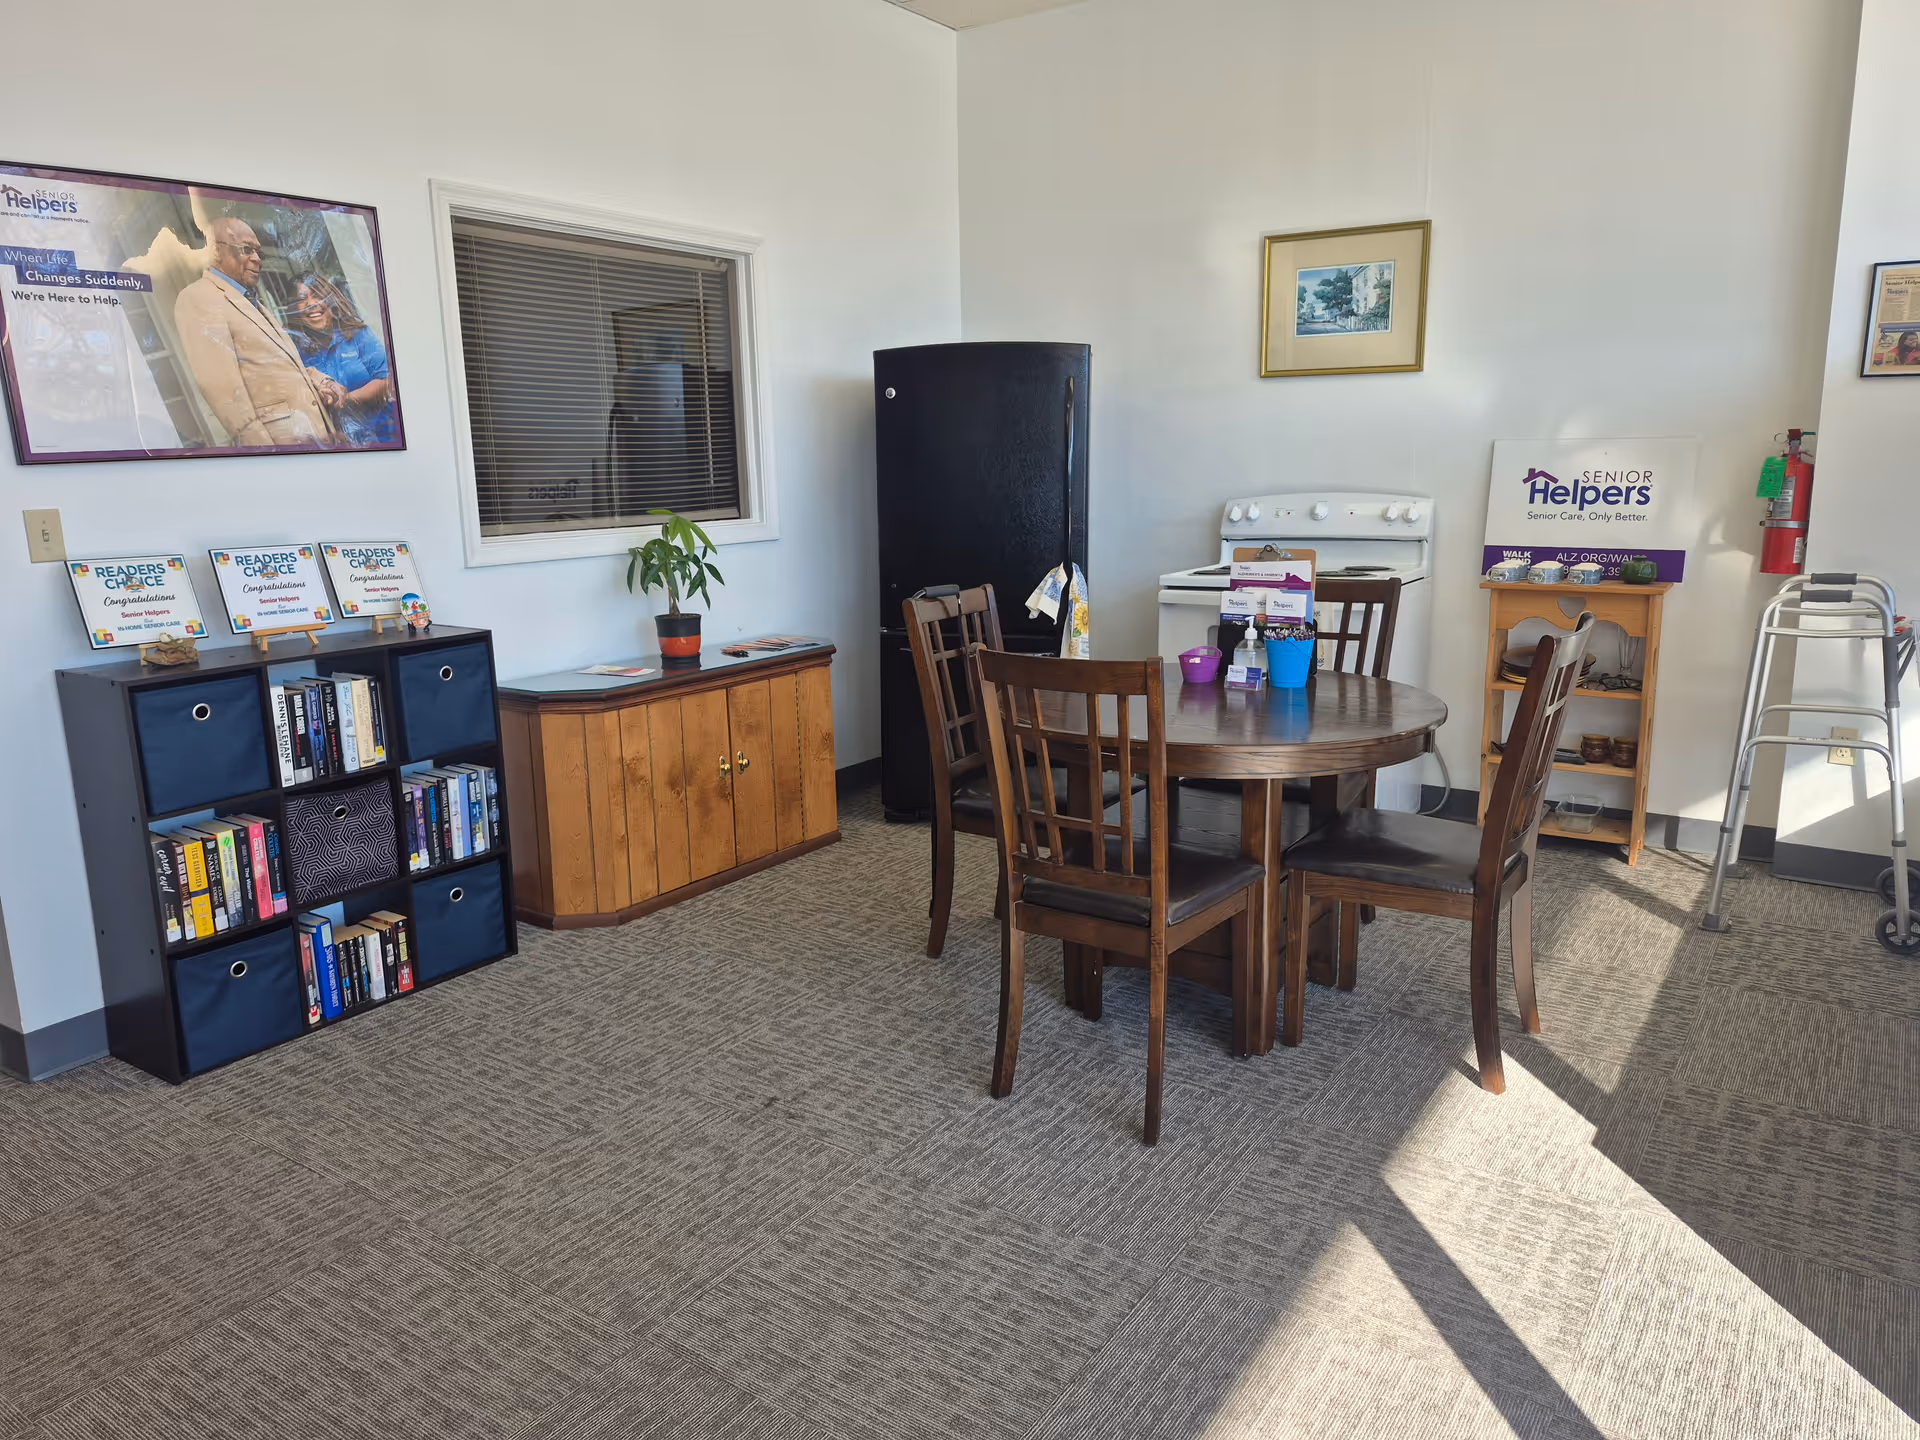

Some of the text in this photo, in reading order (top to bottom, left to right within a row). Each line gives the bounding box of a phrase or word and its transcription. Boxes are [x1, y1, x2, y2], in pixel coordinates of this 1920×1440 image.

[36, 190, 75, 201] SENIOR
[6, 192, 78, 214] Helpers
[4, 250, 69, 265] When Life
[26, 270, 144, 290] Changes Suddenly,
[11, 290, 122, 307] We're Here to Help.
[1582, 470, 1653, 484] SENIOR
[1528, 479, 1652, 511] Helpers
[1527, 511, 1648, 523] Senior Care, Only Better.
[234, 552, 298, 566] READERS
[342, 548, 396, 559] READERS
[1503, 550, 1532, 558] WALK
[94, 564, 166, 578] READERS
[349, 573, 404, 584] Congratulations
[242, 581, 306, 594] Congratulations
[103, 594, 176, 608] Congratulations
[278, 596, 300, 604] Helpers
[121, 609, 170, 619] Senior Helpers
[144, 622, 165, 630] SENIOR
[277, 694, 292, 764] DENNIS LEHANE
[157, 849, 172, 876] career
[208, 854, 216, 882] NAMES
[160, 876, 176, 894] evil
